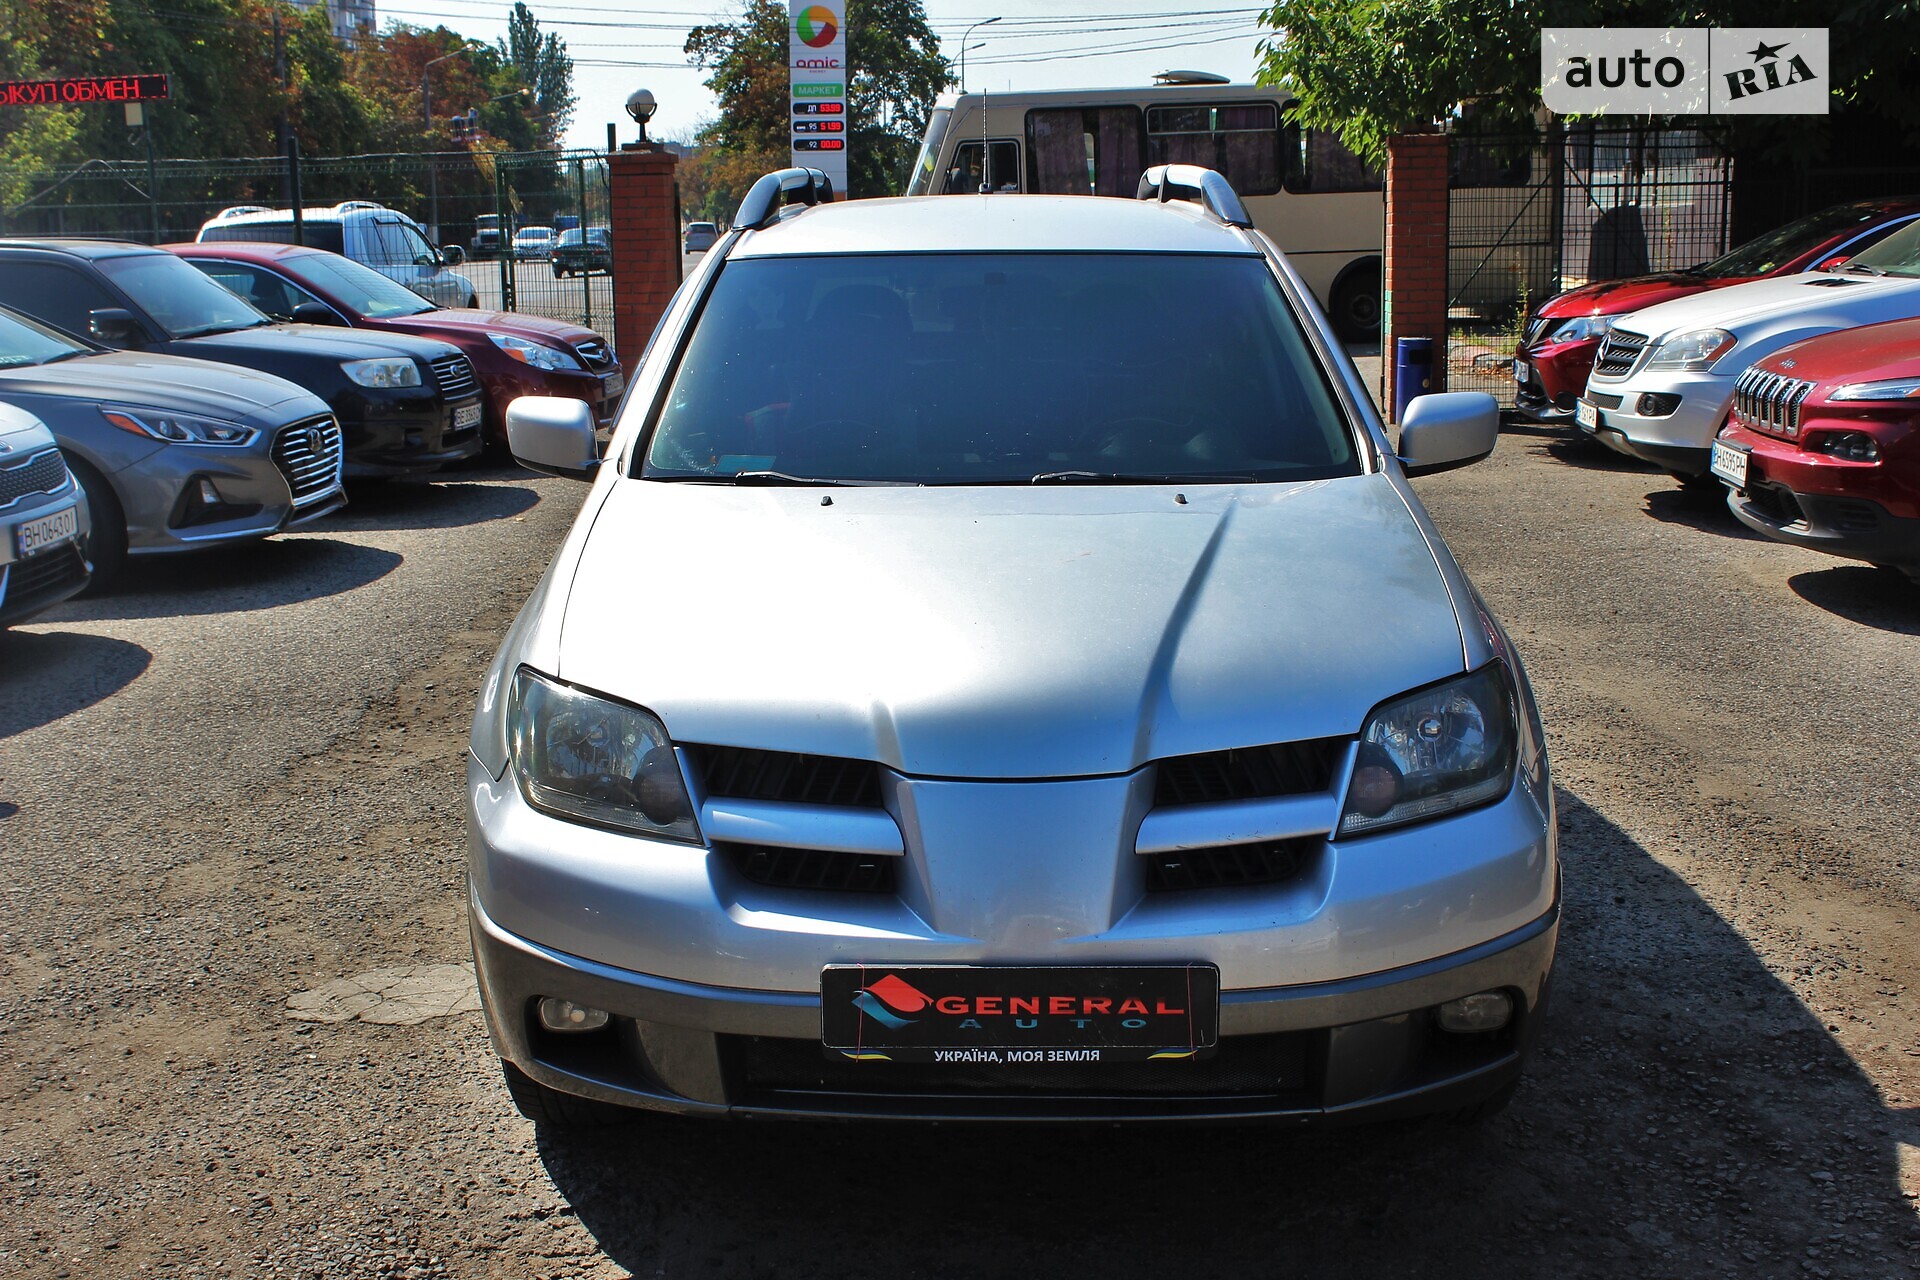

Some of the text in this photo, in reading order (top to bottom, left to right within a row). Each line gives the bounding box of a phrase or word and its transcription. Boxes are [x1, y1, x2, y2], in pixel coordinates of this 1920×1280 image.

[796, 56, 840, 69] amic
[62, 79, 141, 102] ОБМЕН
[798, 86, 837, 95] МАРКЕТ
[936, 996, 1185, 1015] GENERAL
[959, 1018, 1147, 1029] AUTO
[934, 1048, 1100, 1064] УКРАЇНА, МОЯ ЗЕМЛЯ
